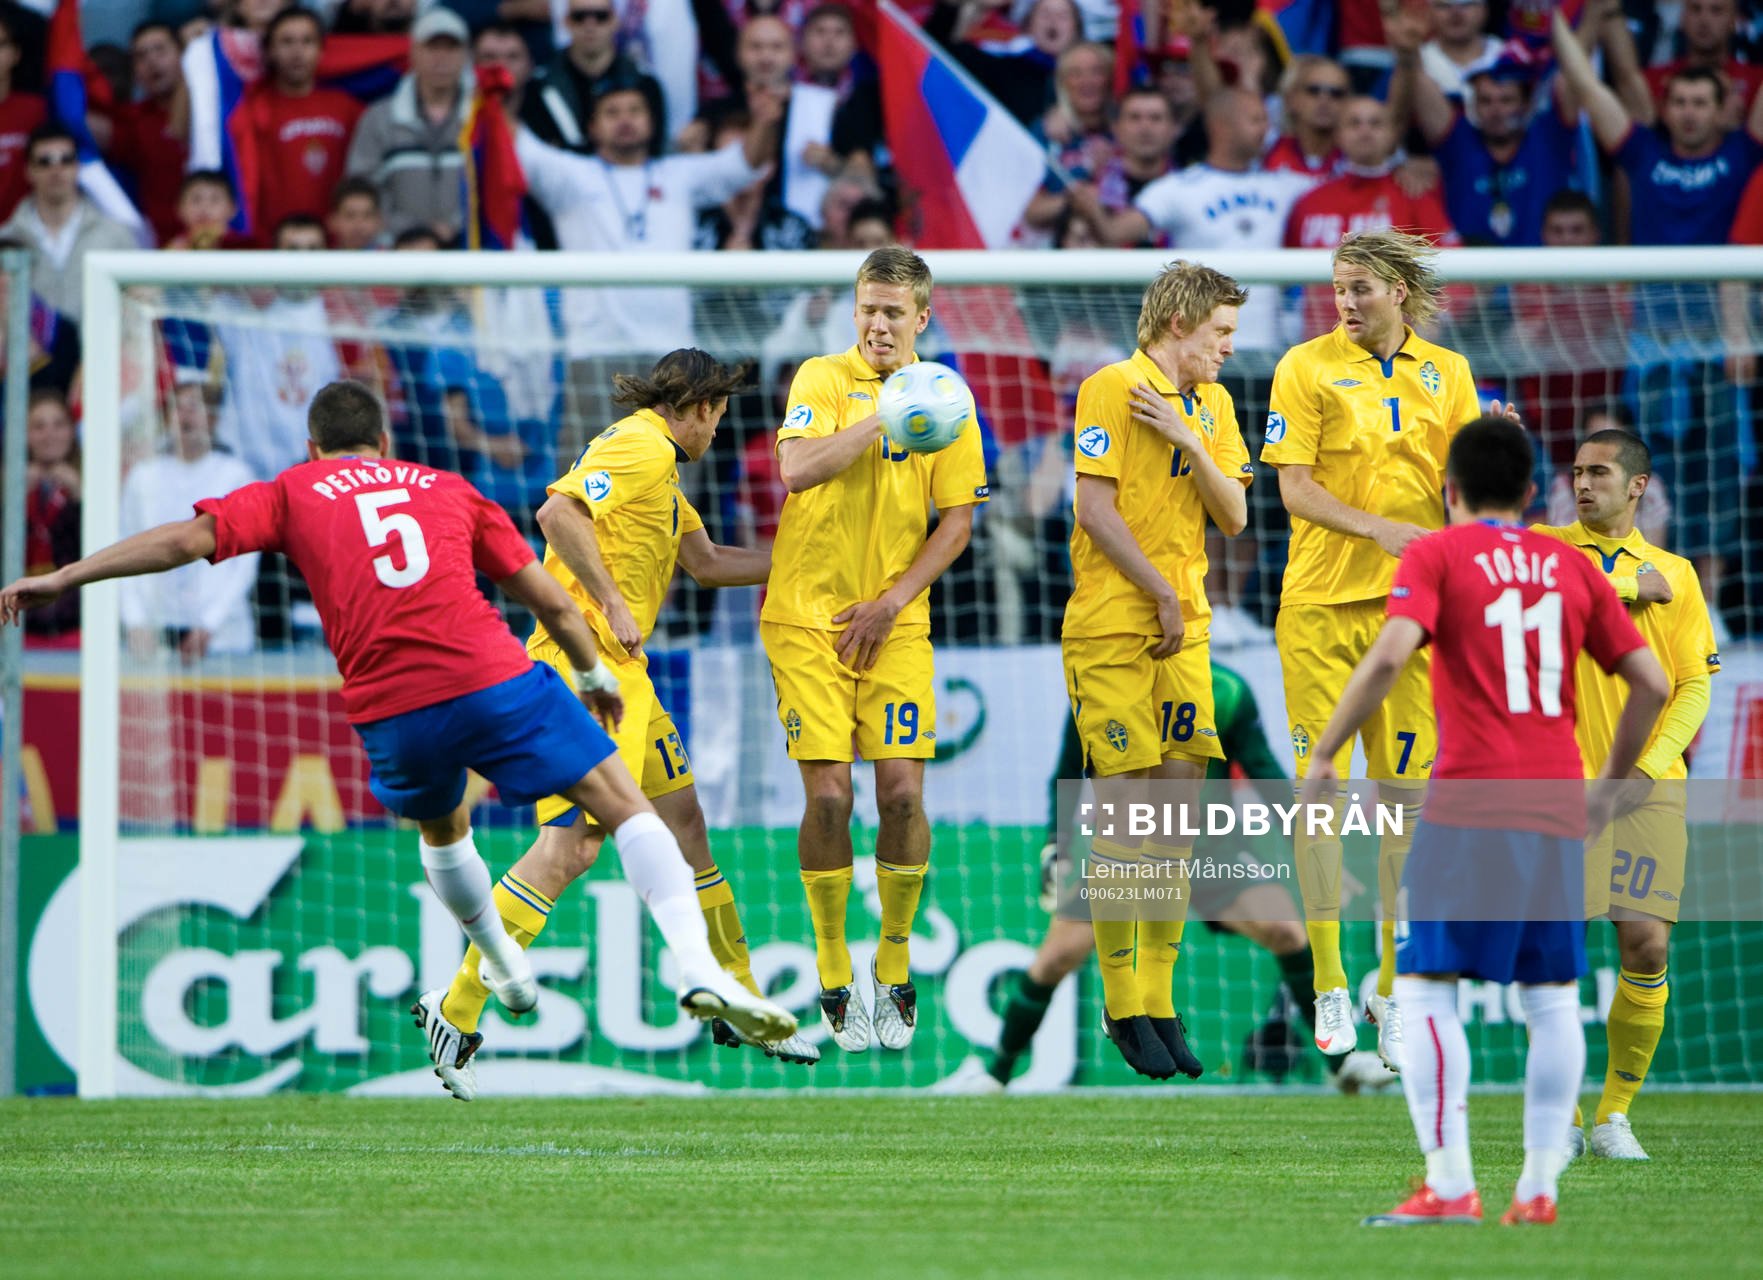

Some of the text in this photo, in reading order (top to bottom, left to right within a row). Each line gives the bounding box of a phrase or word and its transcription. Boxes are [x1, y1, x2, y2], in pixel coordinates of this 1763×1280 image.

[312, 466, 438, 501] PETKOVIĆ
[353, 487, 431, 589] 5
[1473, 544, 1559, 589] TOŠIĆ
[1484, 587, 1564, 717] 11
[884, 701, 919, 745] 19
[1161, 701, 1197, 743] 18
[1396, 731, 1417, 775] 7
[1610, 849, 1657, 899] 20
